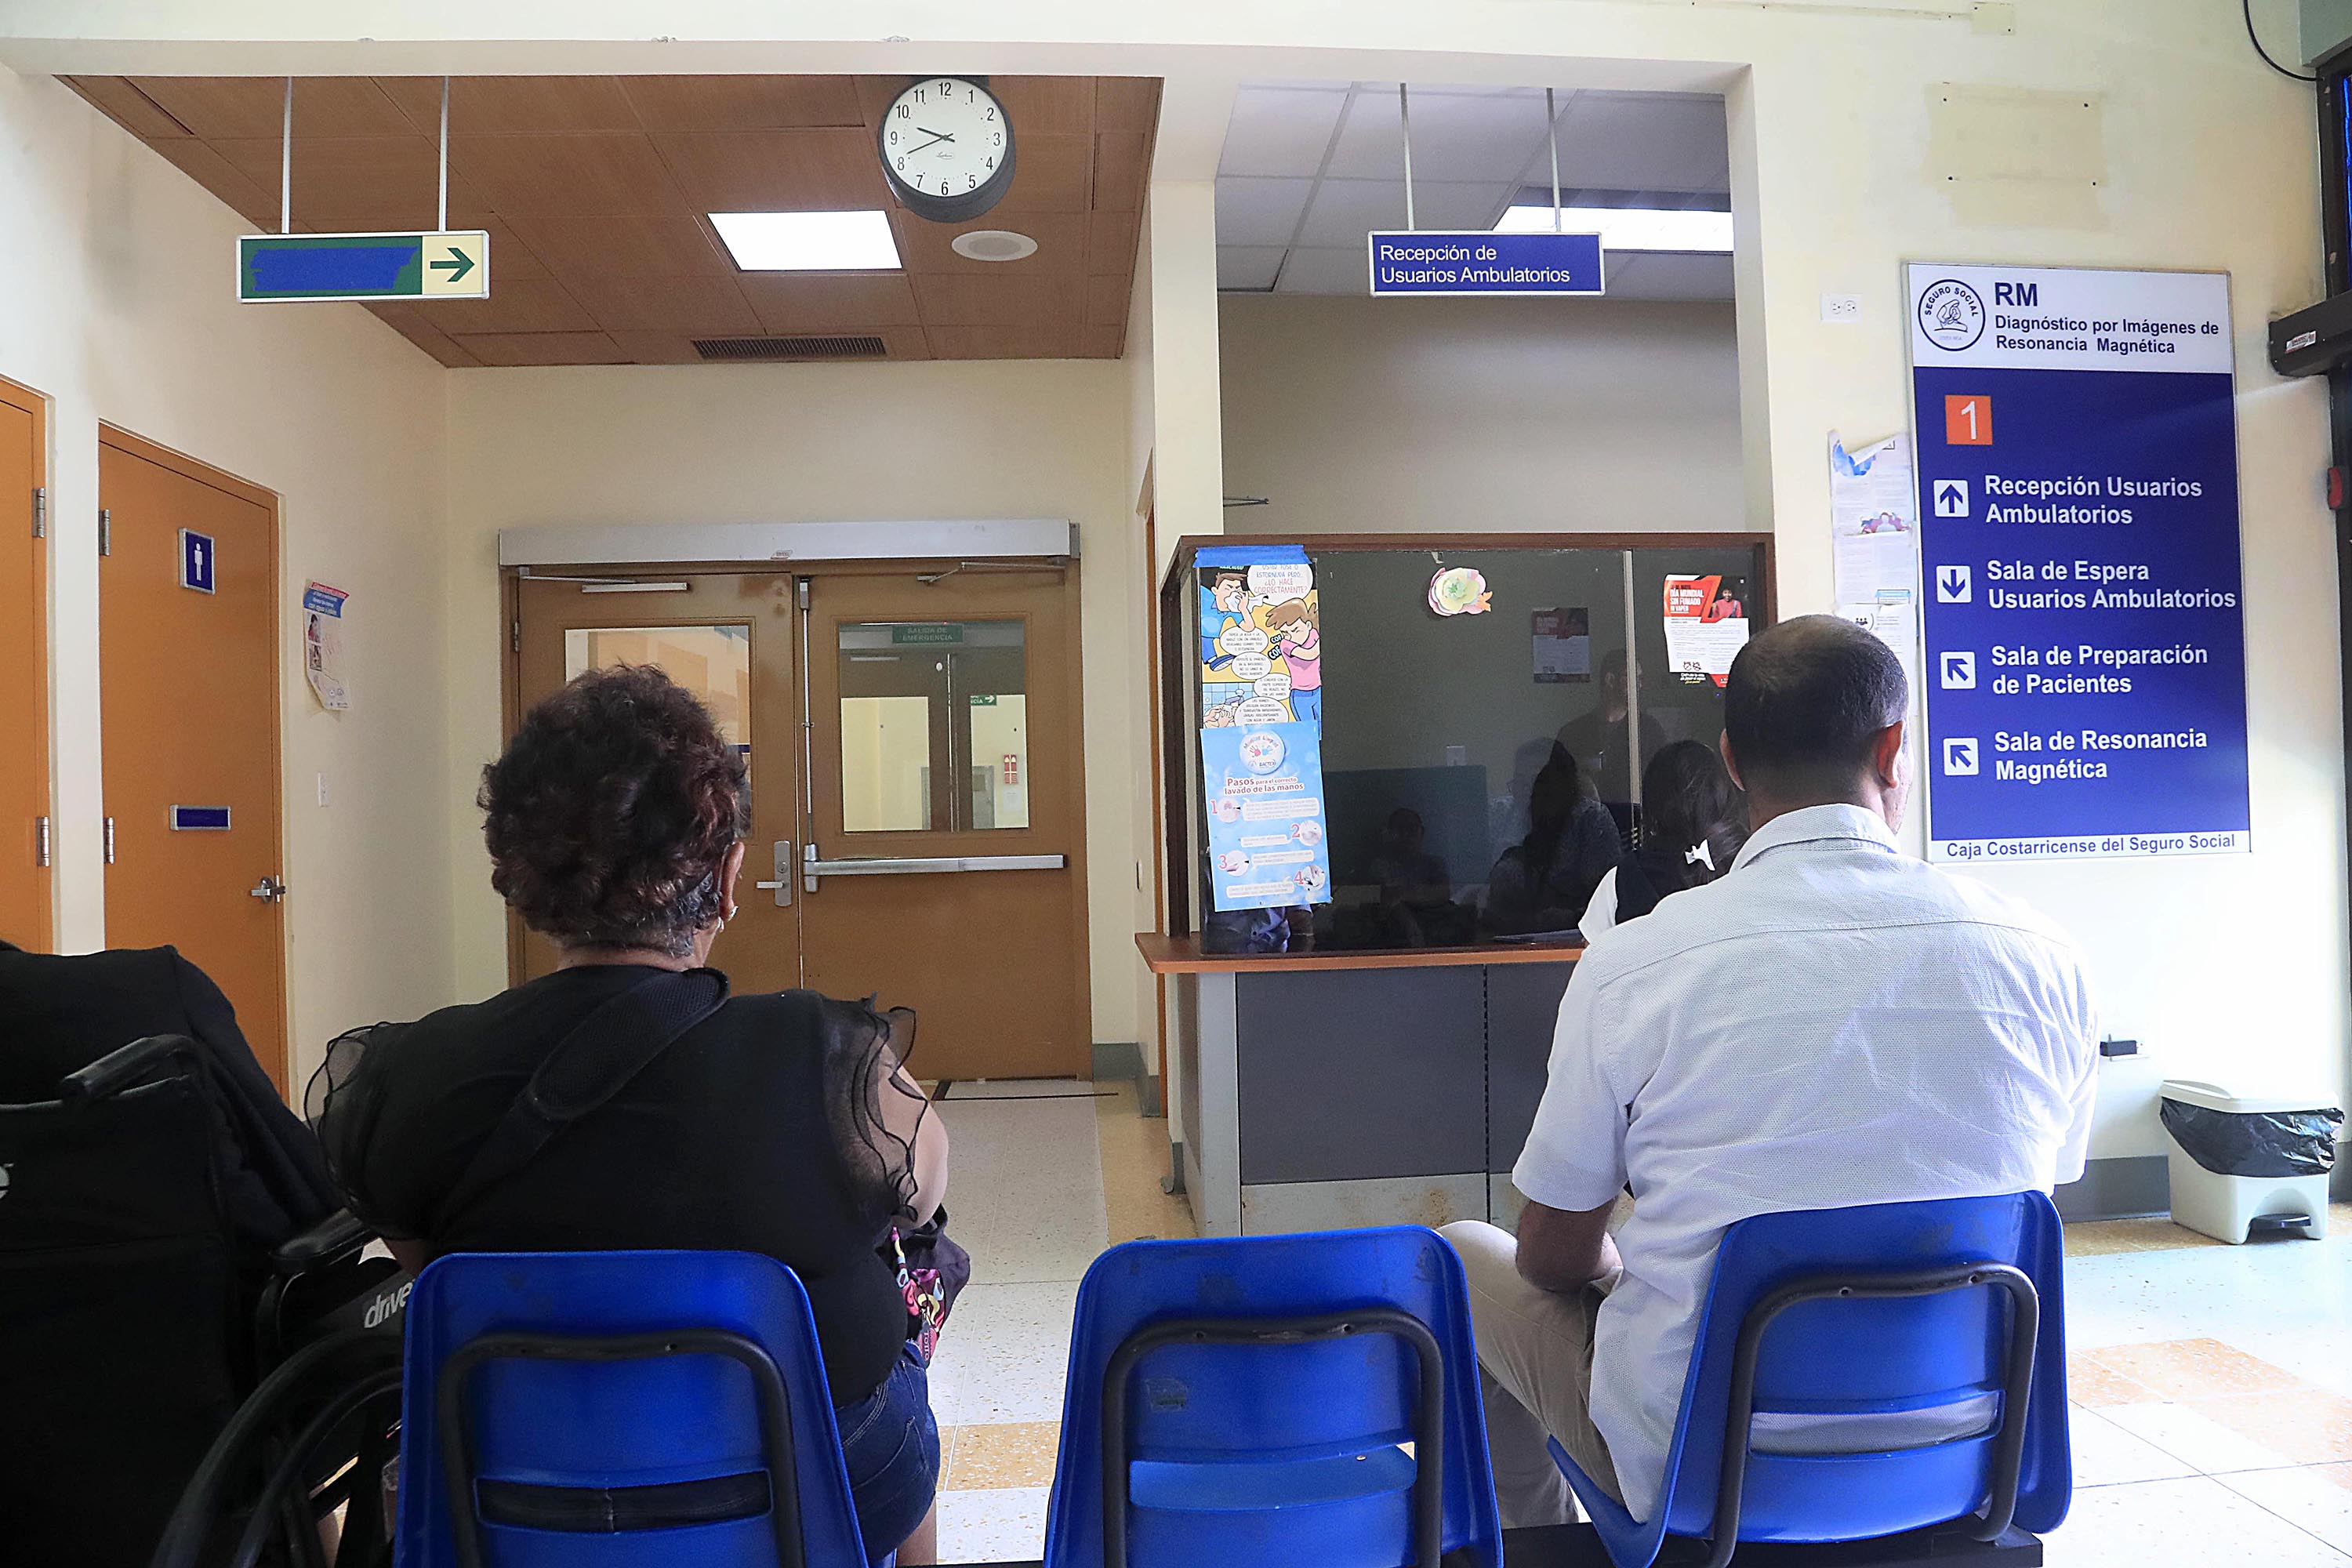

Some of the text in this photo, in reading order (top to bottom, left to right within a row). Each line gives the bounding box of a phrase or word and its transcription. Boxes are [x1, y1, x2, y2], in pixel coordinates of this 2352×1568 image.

[913, 89, 925, 103] 11
[938, 82, 951, 96] 12
[969, 89, 973, 103] 1
[896, 104, 909, 118] 10
[987, 107, 993, 121] 2
[891, 132, 897, 145] 9
[993, 132, 1000, 146] 3
[898, 157, 904, 170] 8
[986, 157, 993, 170] 4
[916, 175, 923, 188] 7
[942, 182, 948, 195] 6
[969, 175, 975, 188] 5
[1381, 245, 1497, 263] Recepción de
[1382, 267, 1570, 282] Usuarios Ambulatorios
[1925, 286, 1979, 317] SEGURO SOCIAL
[1994, 282, 2038, 307] RM
[1995, 315, 2218, 336] Diagnóstico por Imágenes de
[1997, 336, 2174, 355] Resonancia Magnética
[1962, 401, 1976, 439] 1
[1985, 475, 2201, 499] Recepción Usuarios
[1986, 503, 2132, 524] Ambulatorios
[1987, 561, 2149, 584] Sala de Espera
[1679, 589, 1704, 597] MUNDIAL
[1989, 589, 2235, 608] Usuarios Ambulatorios
[1679, 597, 1701, 606] FUMADO
[1992, 644, 2207, 669] Sala de Preparación
[1993, 674, 2131, 694] de Pacientes
[1995, 728, 2207, 751] Sala de Resonancia
[1996, 759, 2107, 784] Magnética
[1227, 778, 1254, 786] Pasos
[1225, 786, 1251, 795] lavado
[1210, 800, 1218, 815] 1
[1290, 824, 1300, 839] 2
[1947, 834, 2234, 859] Caja Costarricense del Seguro Social
[1219, 855, 1228, 869] 3
[1294, 871, 1304, 885] 4
[364, 1282, 413, 1328] drive
